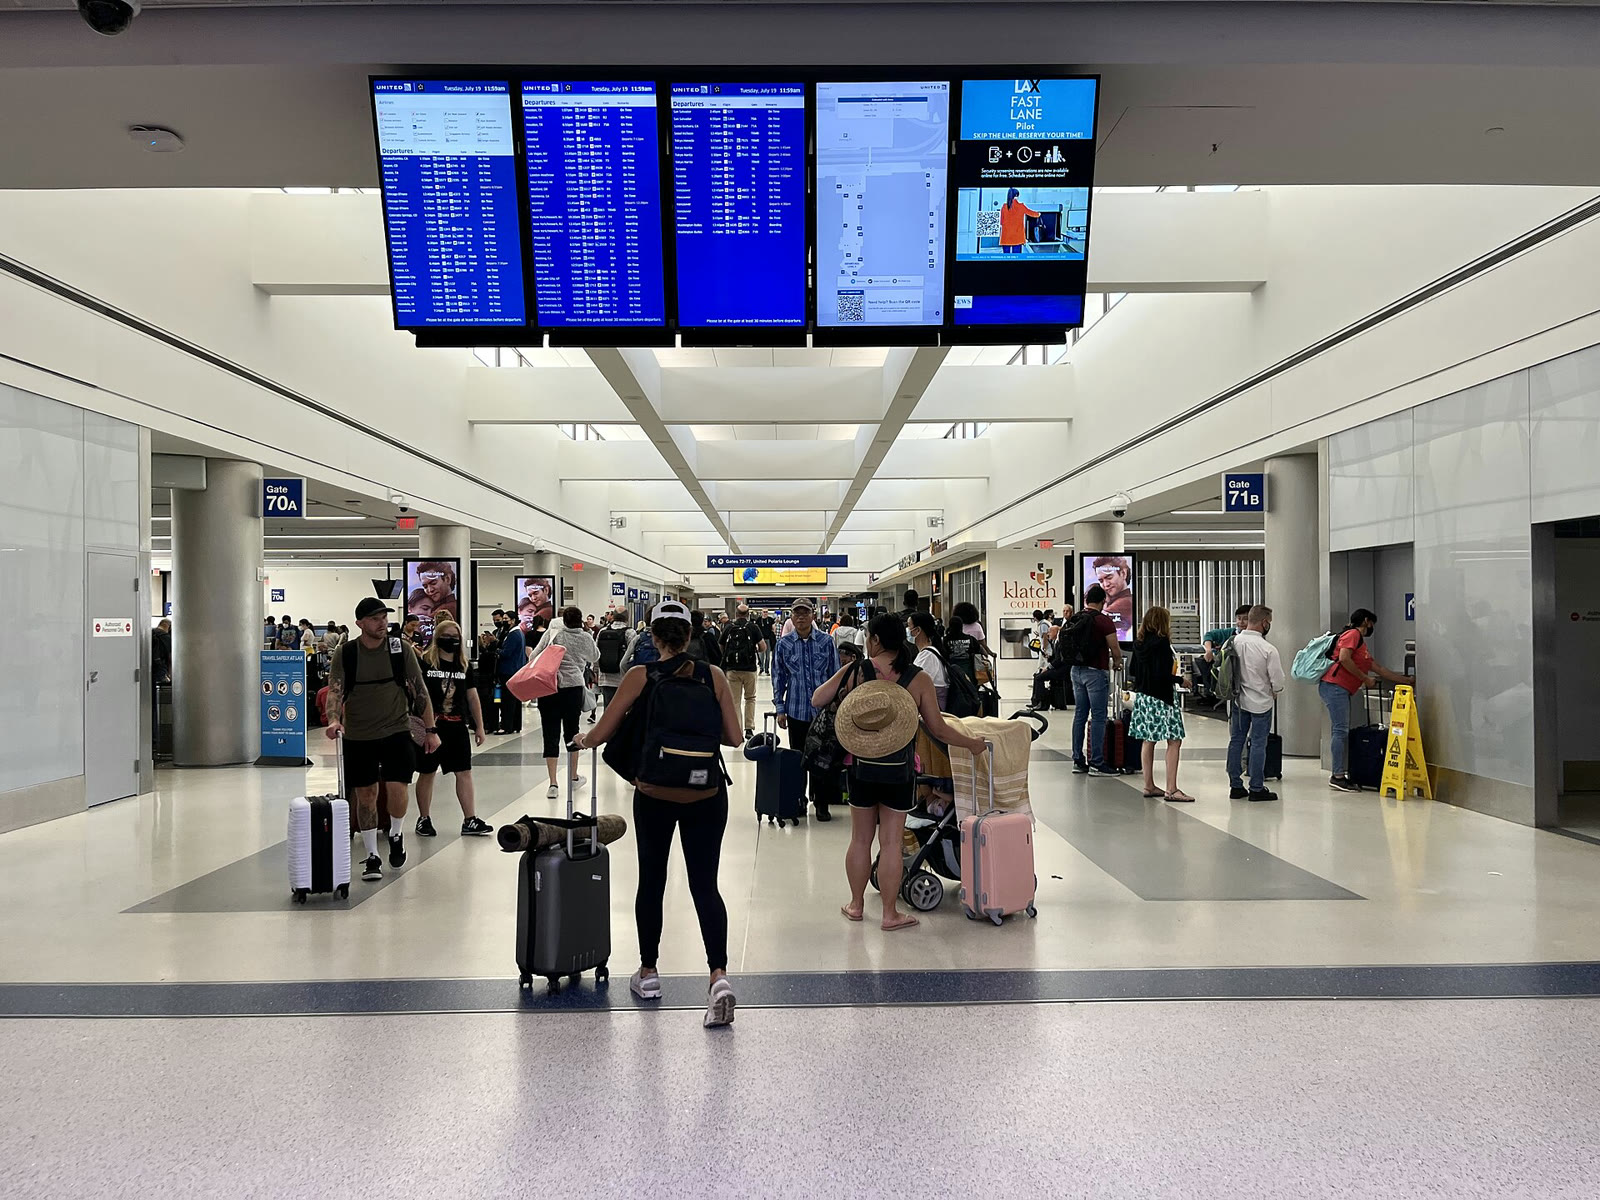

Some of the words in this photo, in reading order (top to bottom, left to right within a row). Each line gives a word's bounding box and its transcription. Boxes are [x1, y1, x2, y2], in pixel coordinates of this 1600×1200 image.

[1014, 80, 1040, 93] LAX
[1011, 96, 1041, 107] FAST
[1010, 109, 1042, 120] LANE
[266, 485, 288, 493] Gate
[1228, 480, 1250, 488] Gate
[266, 495, 298, 510] 70A
[1228, 490, 1260, 505] 71B
[1003, 581, 1057, 599] klatch
[1010, 600, 1049, 608] COFFEE
[427, 670, 445, 678] SYSTEM
